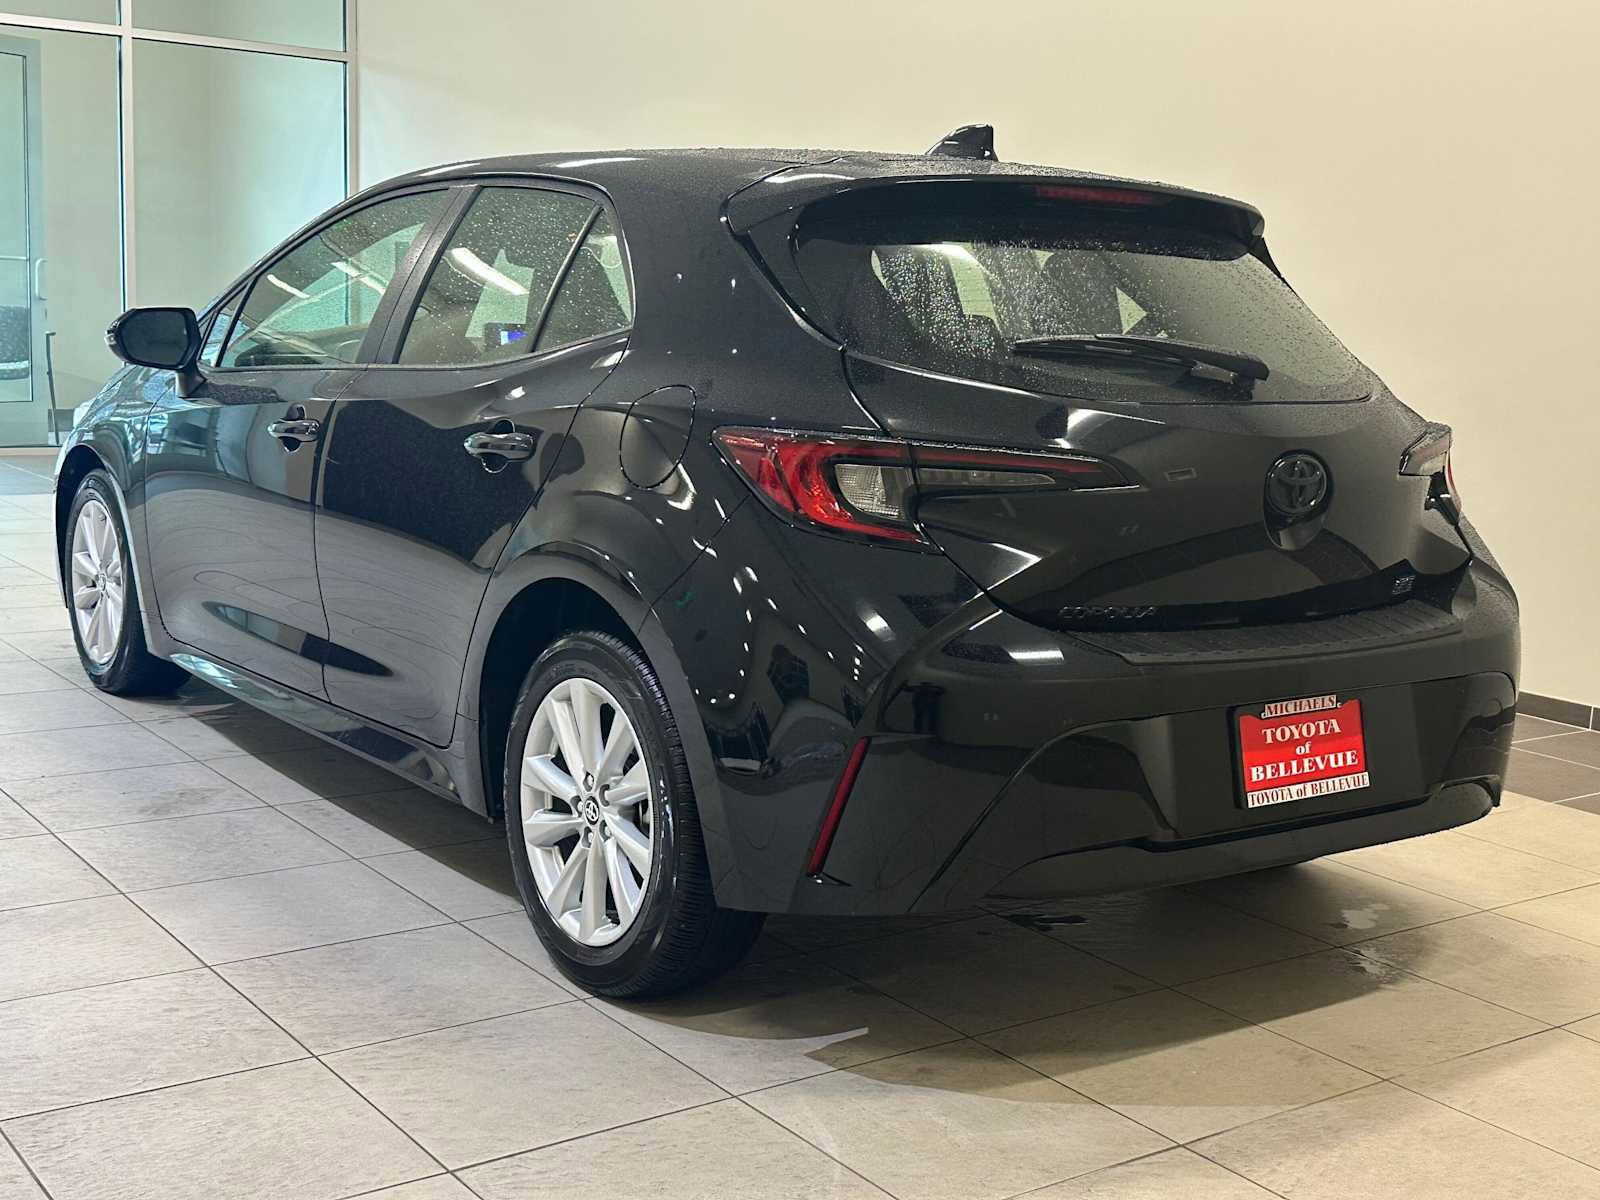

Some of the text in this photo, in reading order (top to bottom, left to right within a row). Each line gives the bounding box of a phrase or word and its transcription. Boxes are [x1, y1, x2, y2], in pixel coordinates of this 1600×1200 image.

[1261, 718, 1342, 744] TOYOTA
[1295, 741, 1313, 755] of
[1249, 750, 1359, 782] BELLEVUE
[1248, 774, 1369, 806] TOYOTA of BELLEVUE
